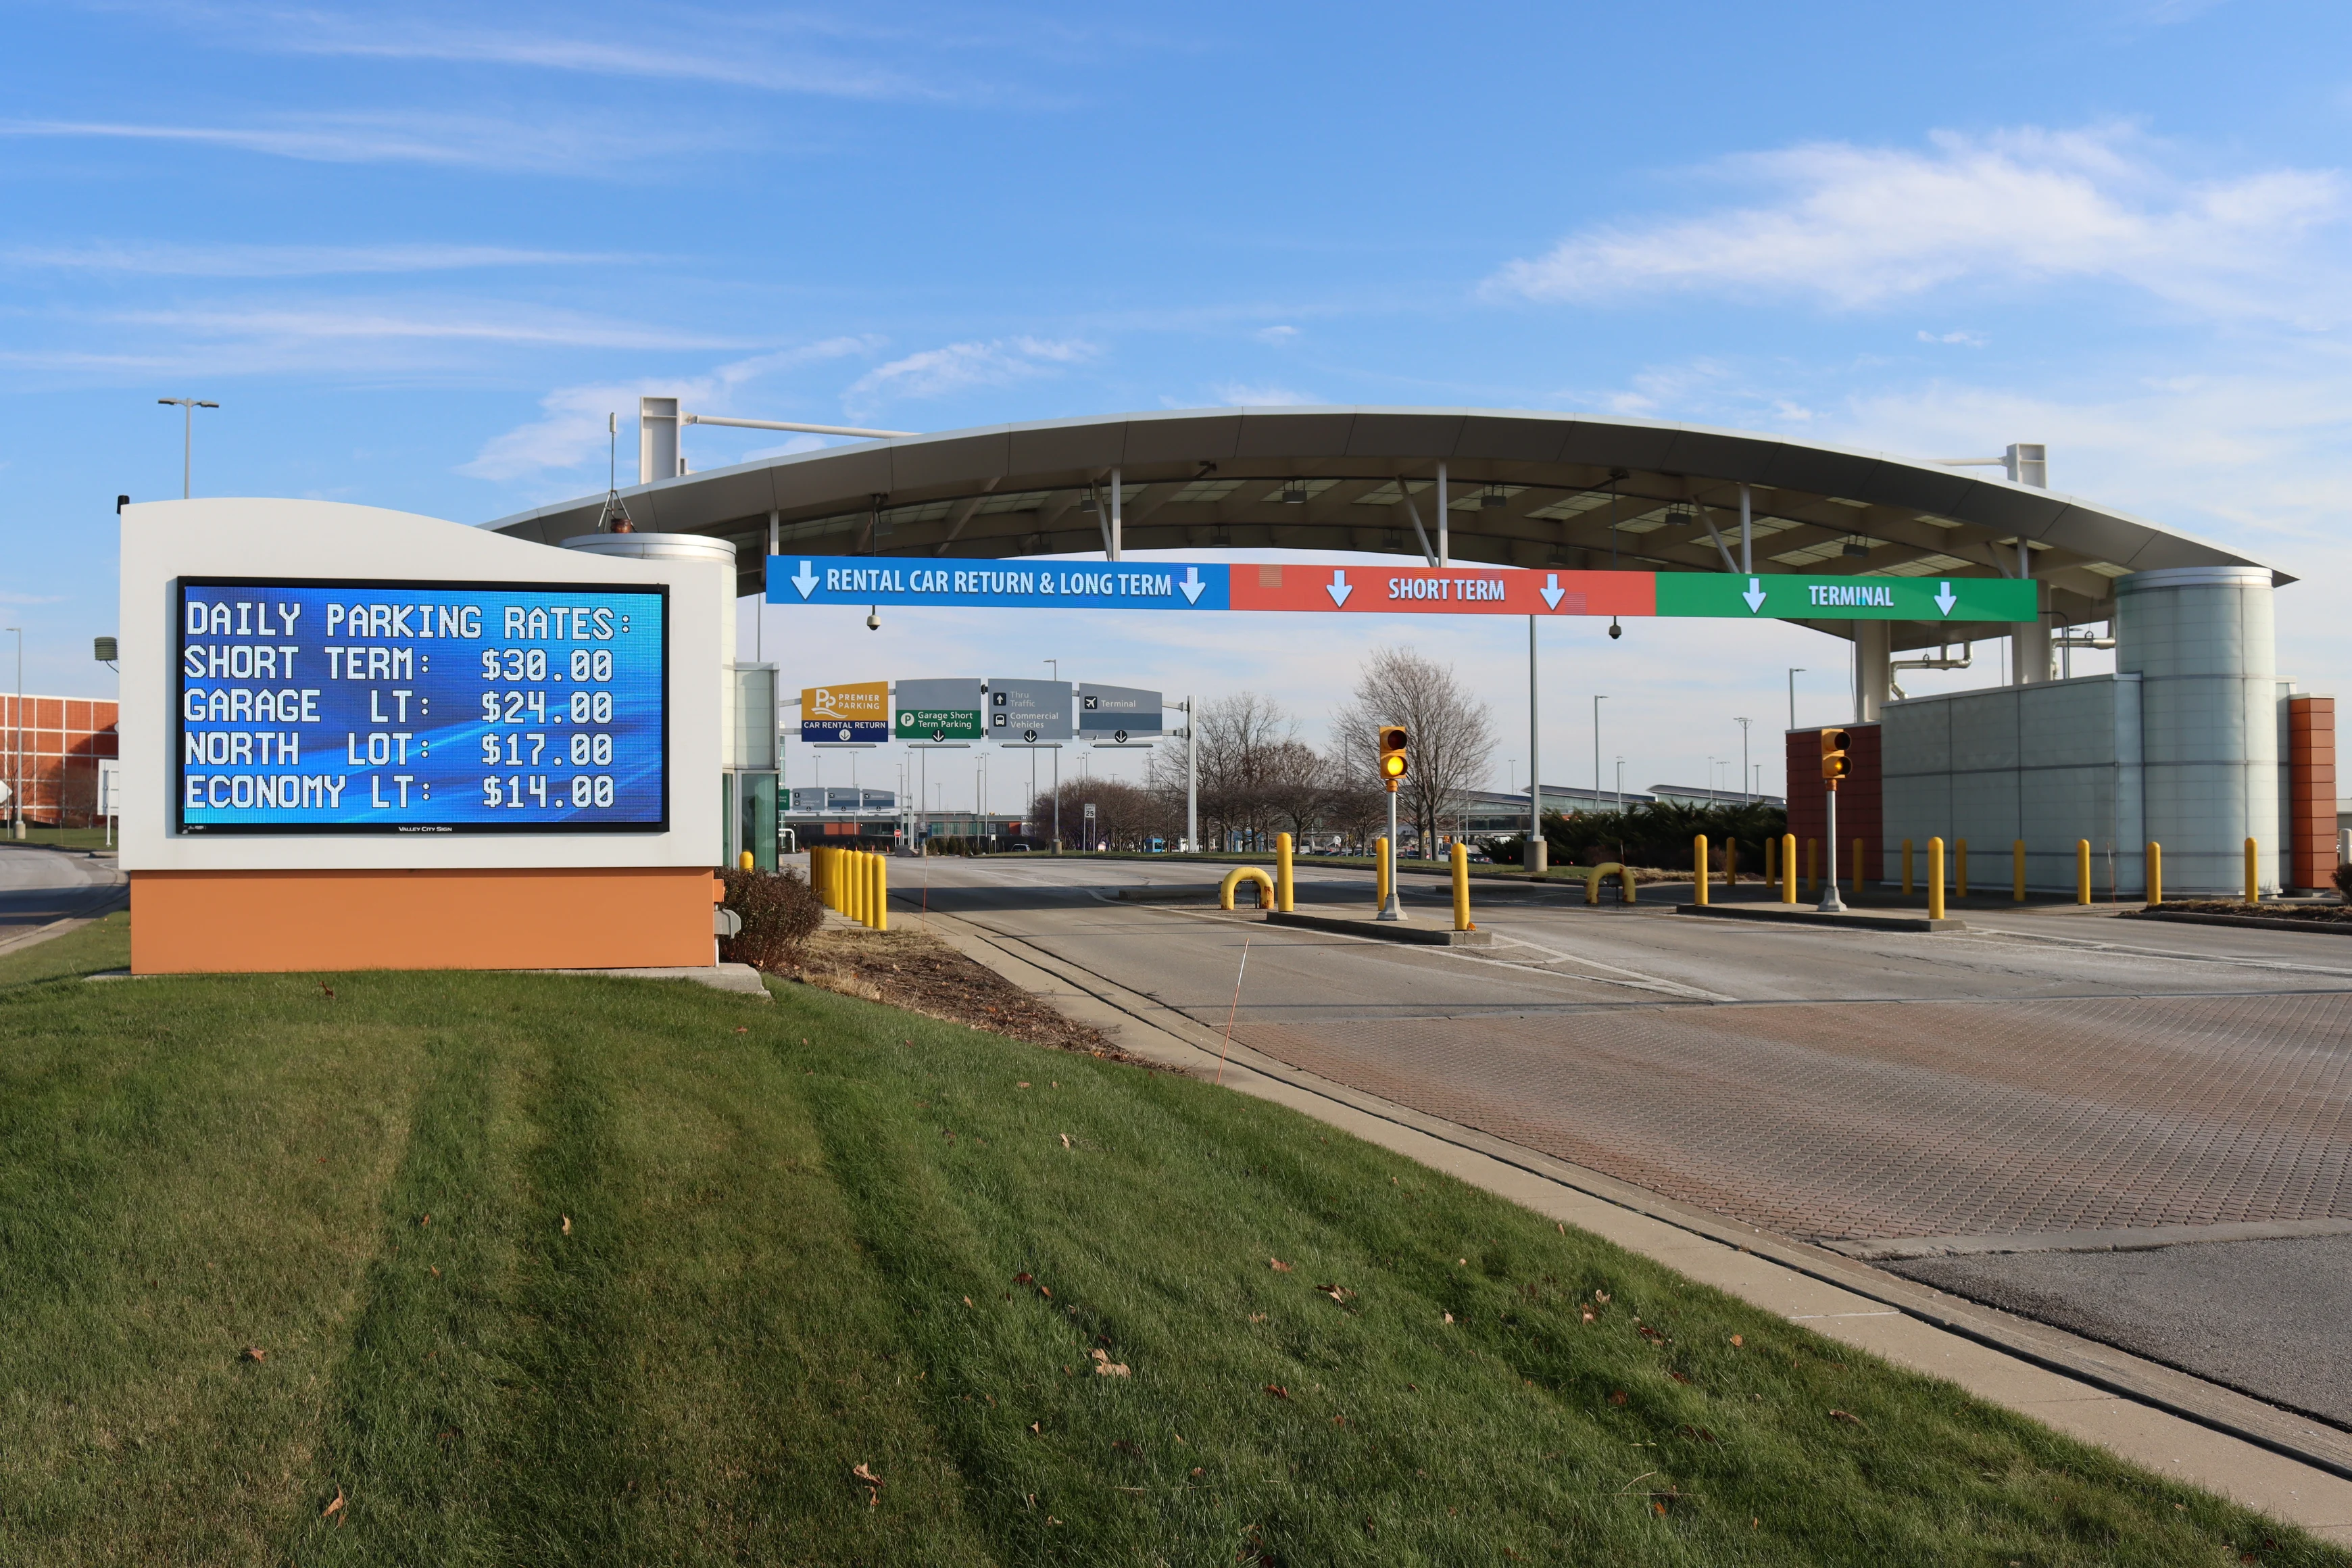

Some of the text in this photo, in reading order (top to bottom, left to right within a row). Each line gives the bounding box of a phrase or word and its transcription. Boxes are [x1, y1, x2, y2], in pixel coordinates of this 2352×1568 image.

[827, 568, 1172, 596] RENTAL CAR RETURN & LONG TERM
[1388, 578, 1505, 601] SHORT TERM
[1808, 585, 1894, 606] TERMINAL
[187, 601, 630, 641] DAILY PARKING RATES:
[184, 644, 614, 682] SHORT TERM: $30.00
[184, 687, 614, 724] GARAGE LT: $24.00
[838, 693, 879, 702] PREMIER
[1100, 700, 1136, 708] Terminal
[917, 712, 948, 720] Garage
[941, 720, 972, 729] Parking
[1010, 720, 1044, 729] Vehicles
[185, 731, 614, 766] NORTH LOT: $17.00
[186, 775, 614, 809] ECONOMY LT: $14.00
